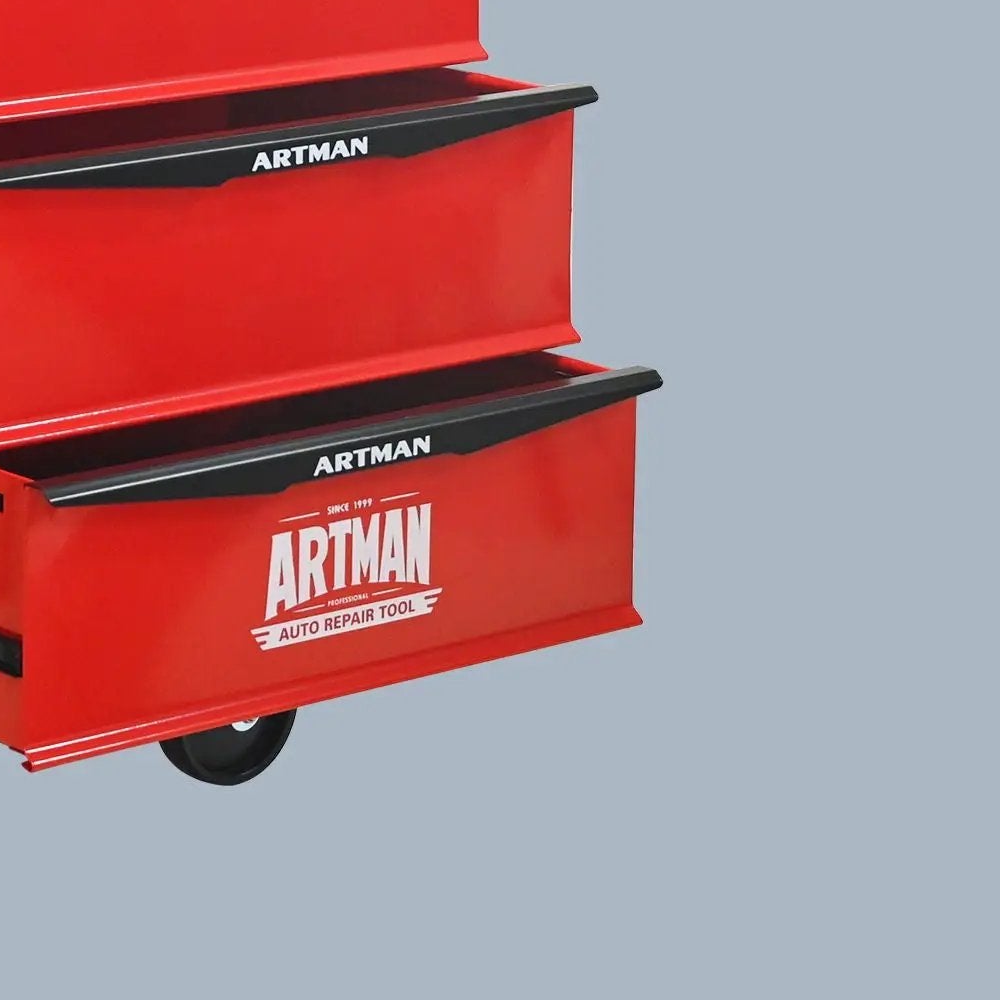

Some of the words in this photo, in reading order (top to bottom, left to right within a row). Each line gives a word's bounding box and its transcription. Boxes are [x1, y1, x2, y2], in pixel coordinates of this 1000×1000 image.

[251, 136, 368, 172] ARTMAN
[313, 435, 431, 476] ARTMAN
[327, 502, 349, 515] SINCE
[354, 498, 373, 510] 1999
[264, 503, 432, 621] ARTMAN
[279, 621, 319, 642] AUTO
[324, 608, 375, 632] REPAIR
[379, 601, 415, 620] TOOL
